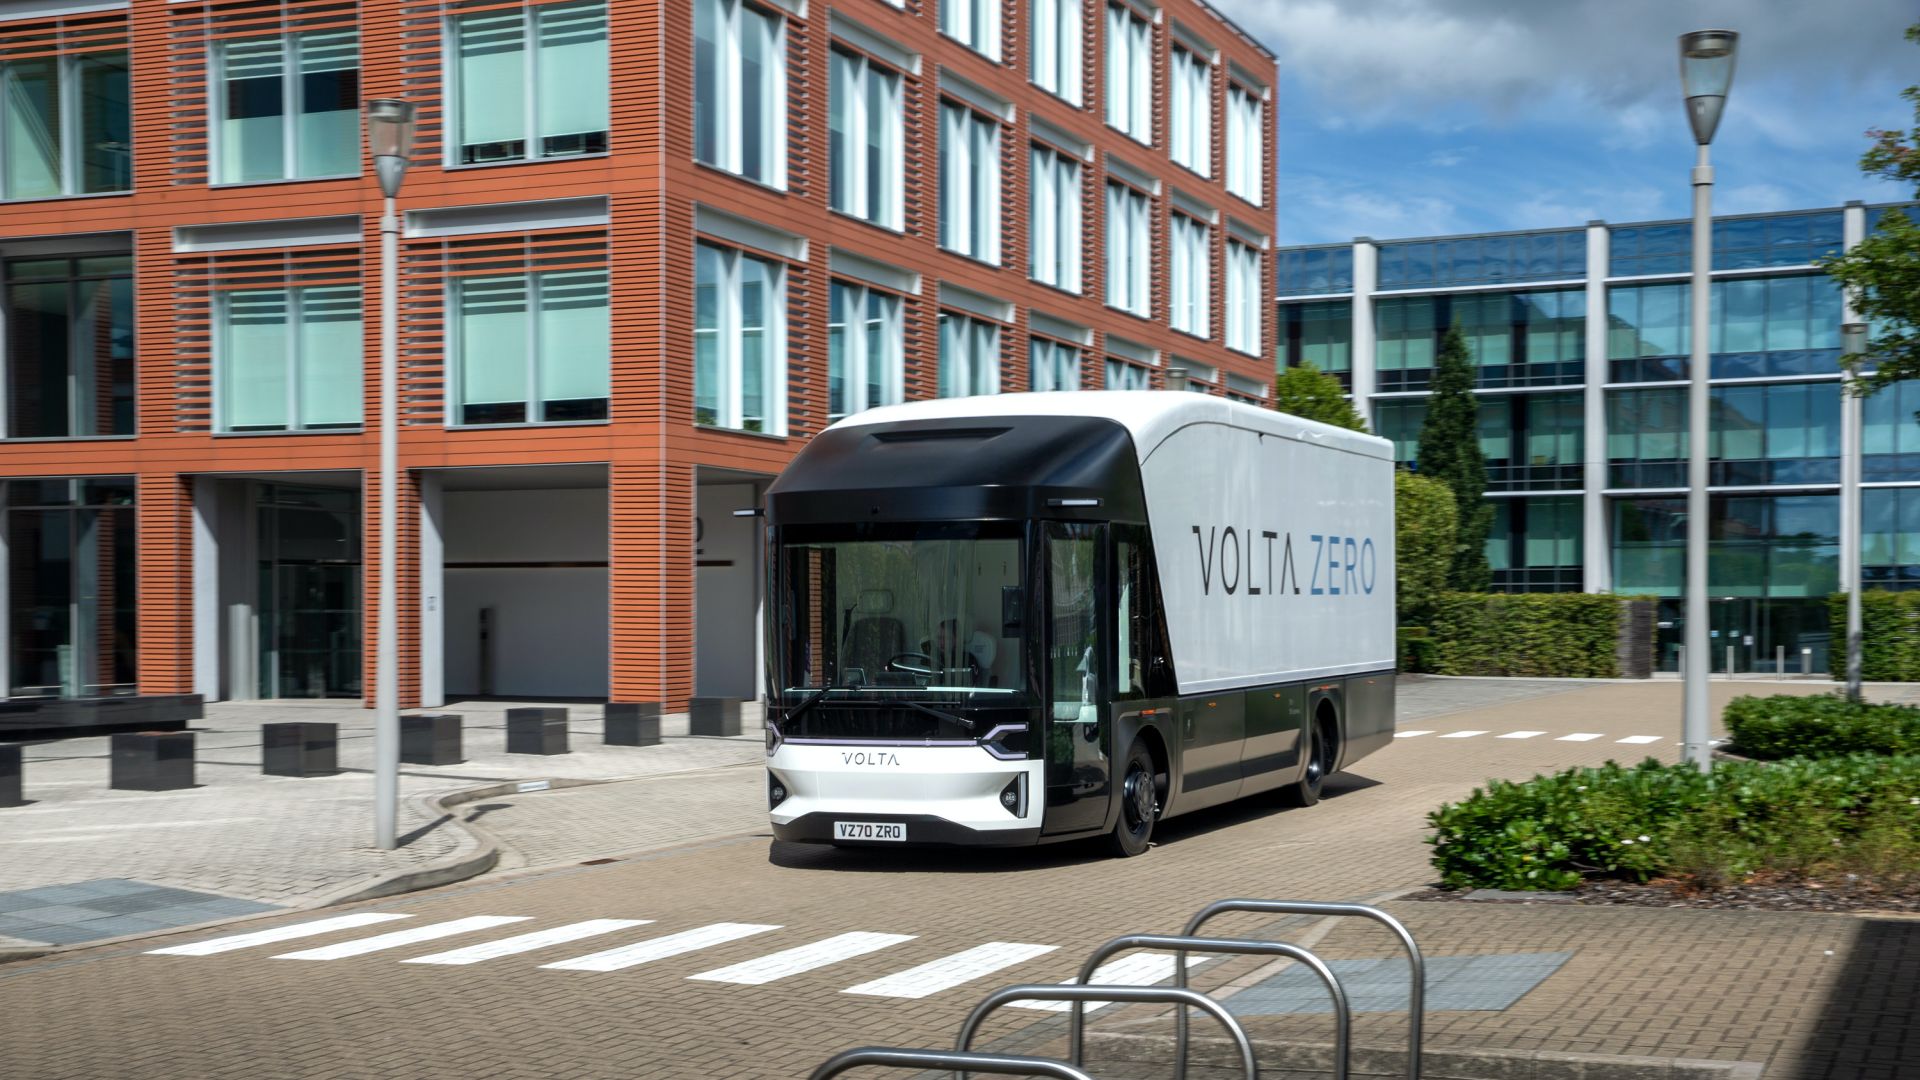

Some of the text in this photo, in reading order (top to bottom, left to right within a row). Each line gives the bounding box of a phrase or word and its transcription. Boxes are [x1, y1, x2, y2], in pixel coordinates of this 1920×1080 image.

[1192, 525, 1377, 596] VOLTA ZERO
[841, 752, 900, 766] VOLTA
[840, 824, 901, 839] VZ70 ZRO
